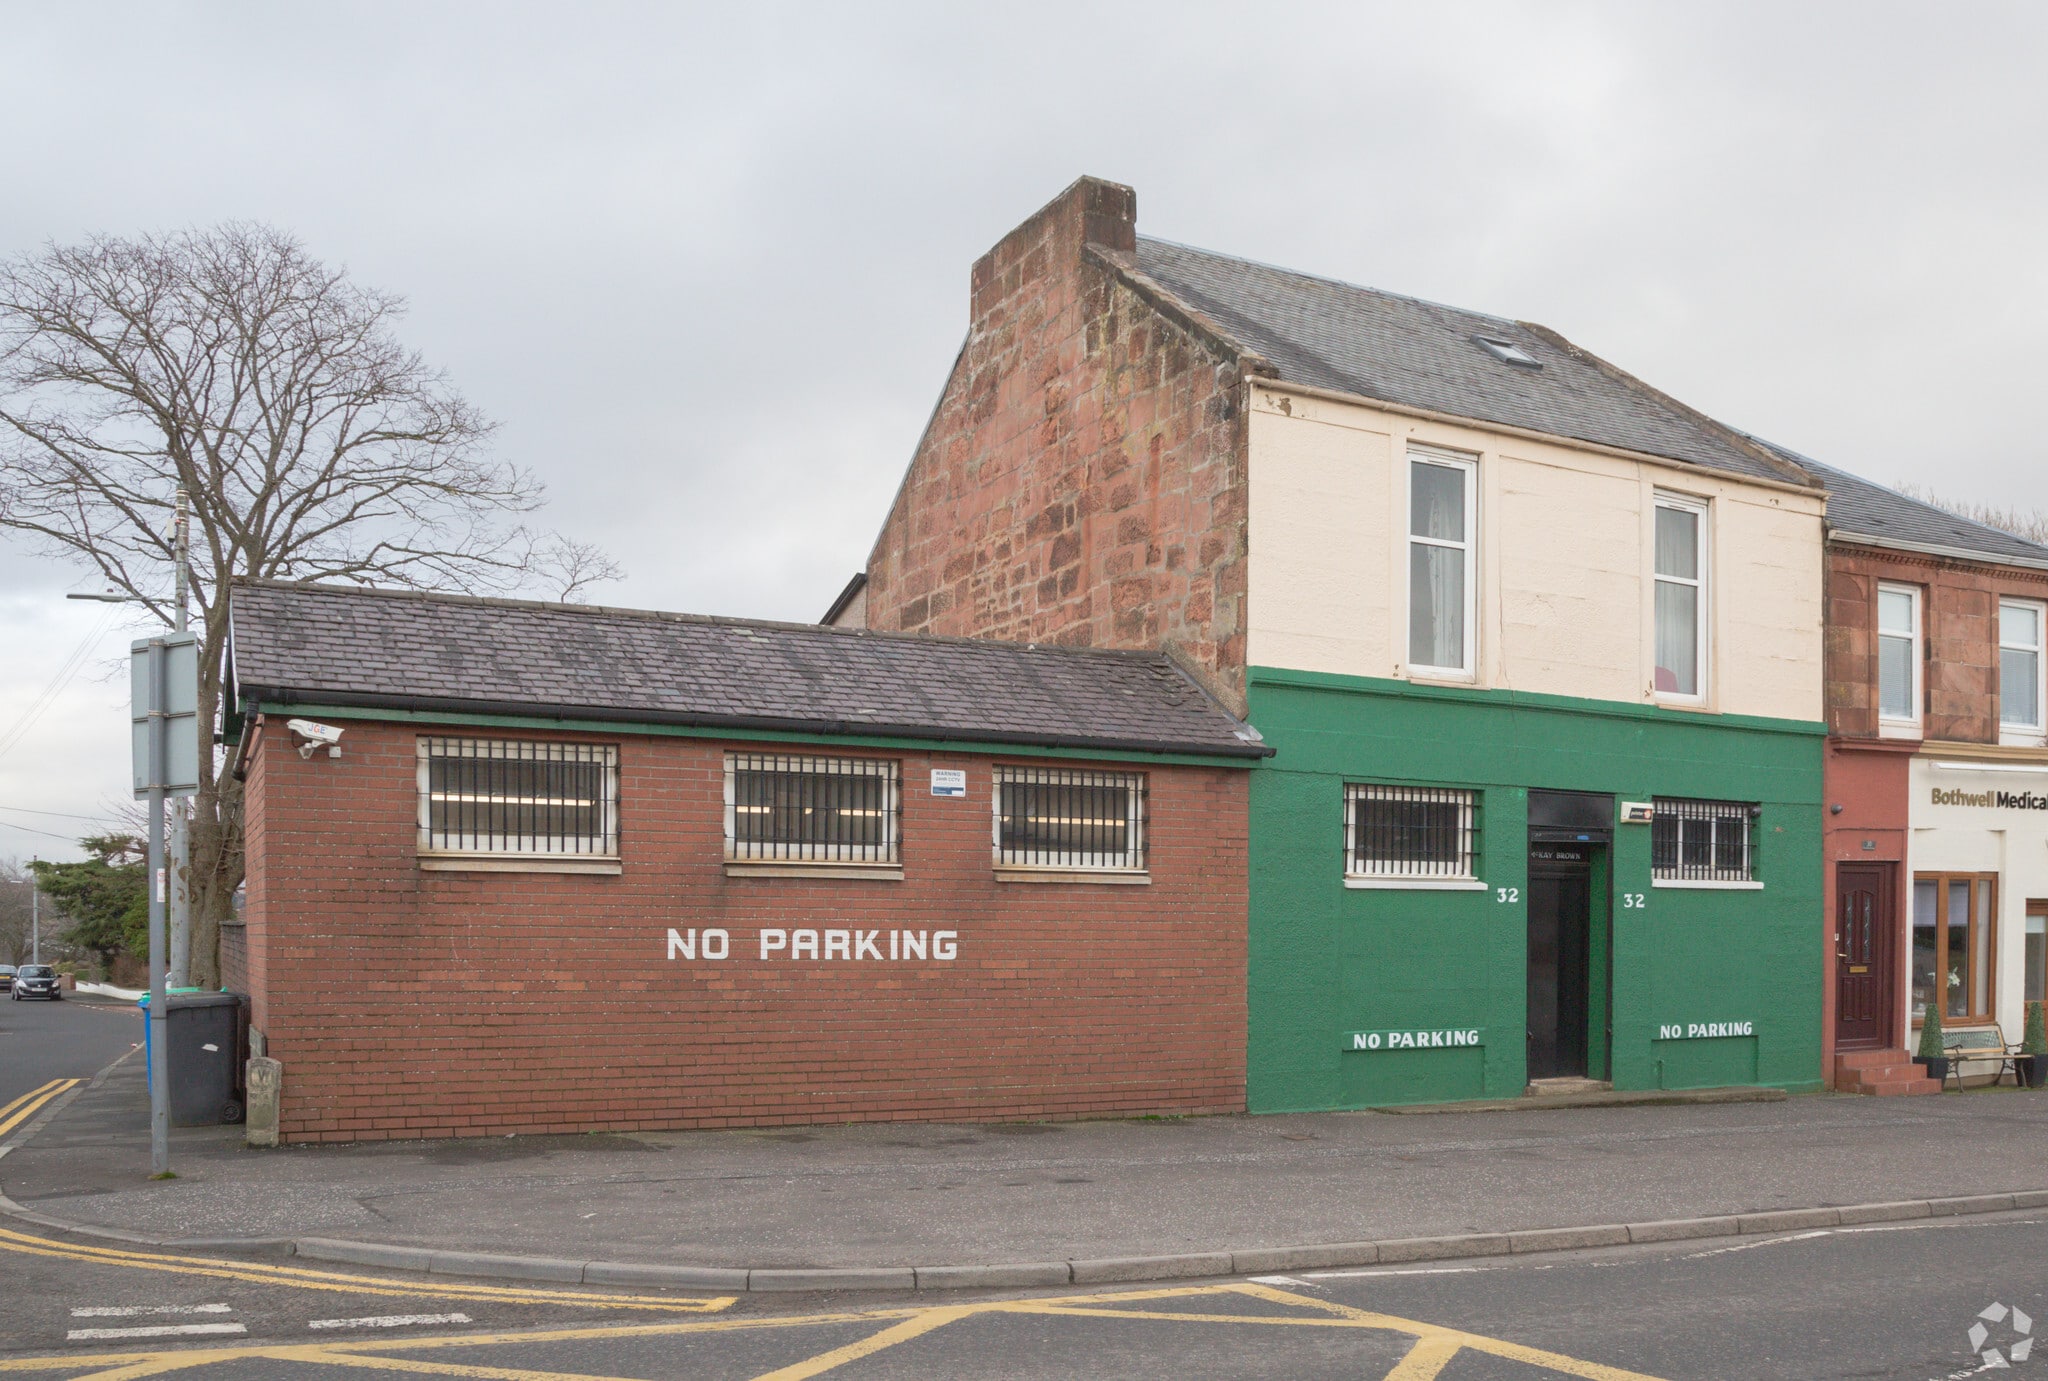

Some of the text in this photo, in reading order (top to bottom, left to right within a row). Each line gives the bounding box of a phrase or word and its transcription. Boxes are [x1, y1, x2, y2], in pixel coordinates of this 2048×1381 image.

[308, 724, 326, 734] JGE
[1931, 787, 1995, 808] Bothwell
[1556, 852, 1581, 860] BROWN
[1497, 887, 1519, 904] 32
[1623, 893, 1645, 909] 32
[667, 928, 958, 961] NO PARKING
[1353, 1029, 1479, 1050] NO PARKING
[1661, 1021, 1752, 1040] NO PARKING
